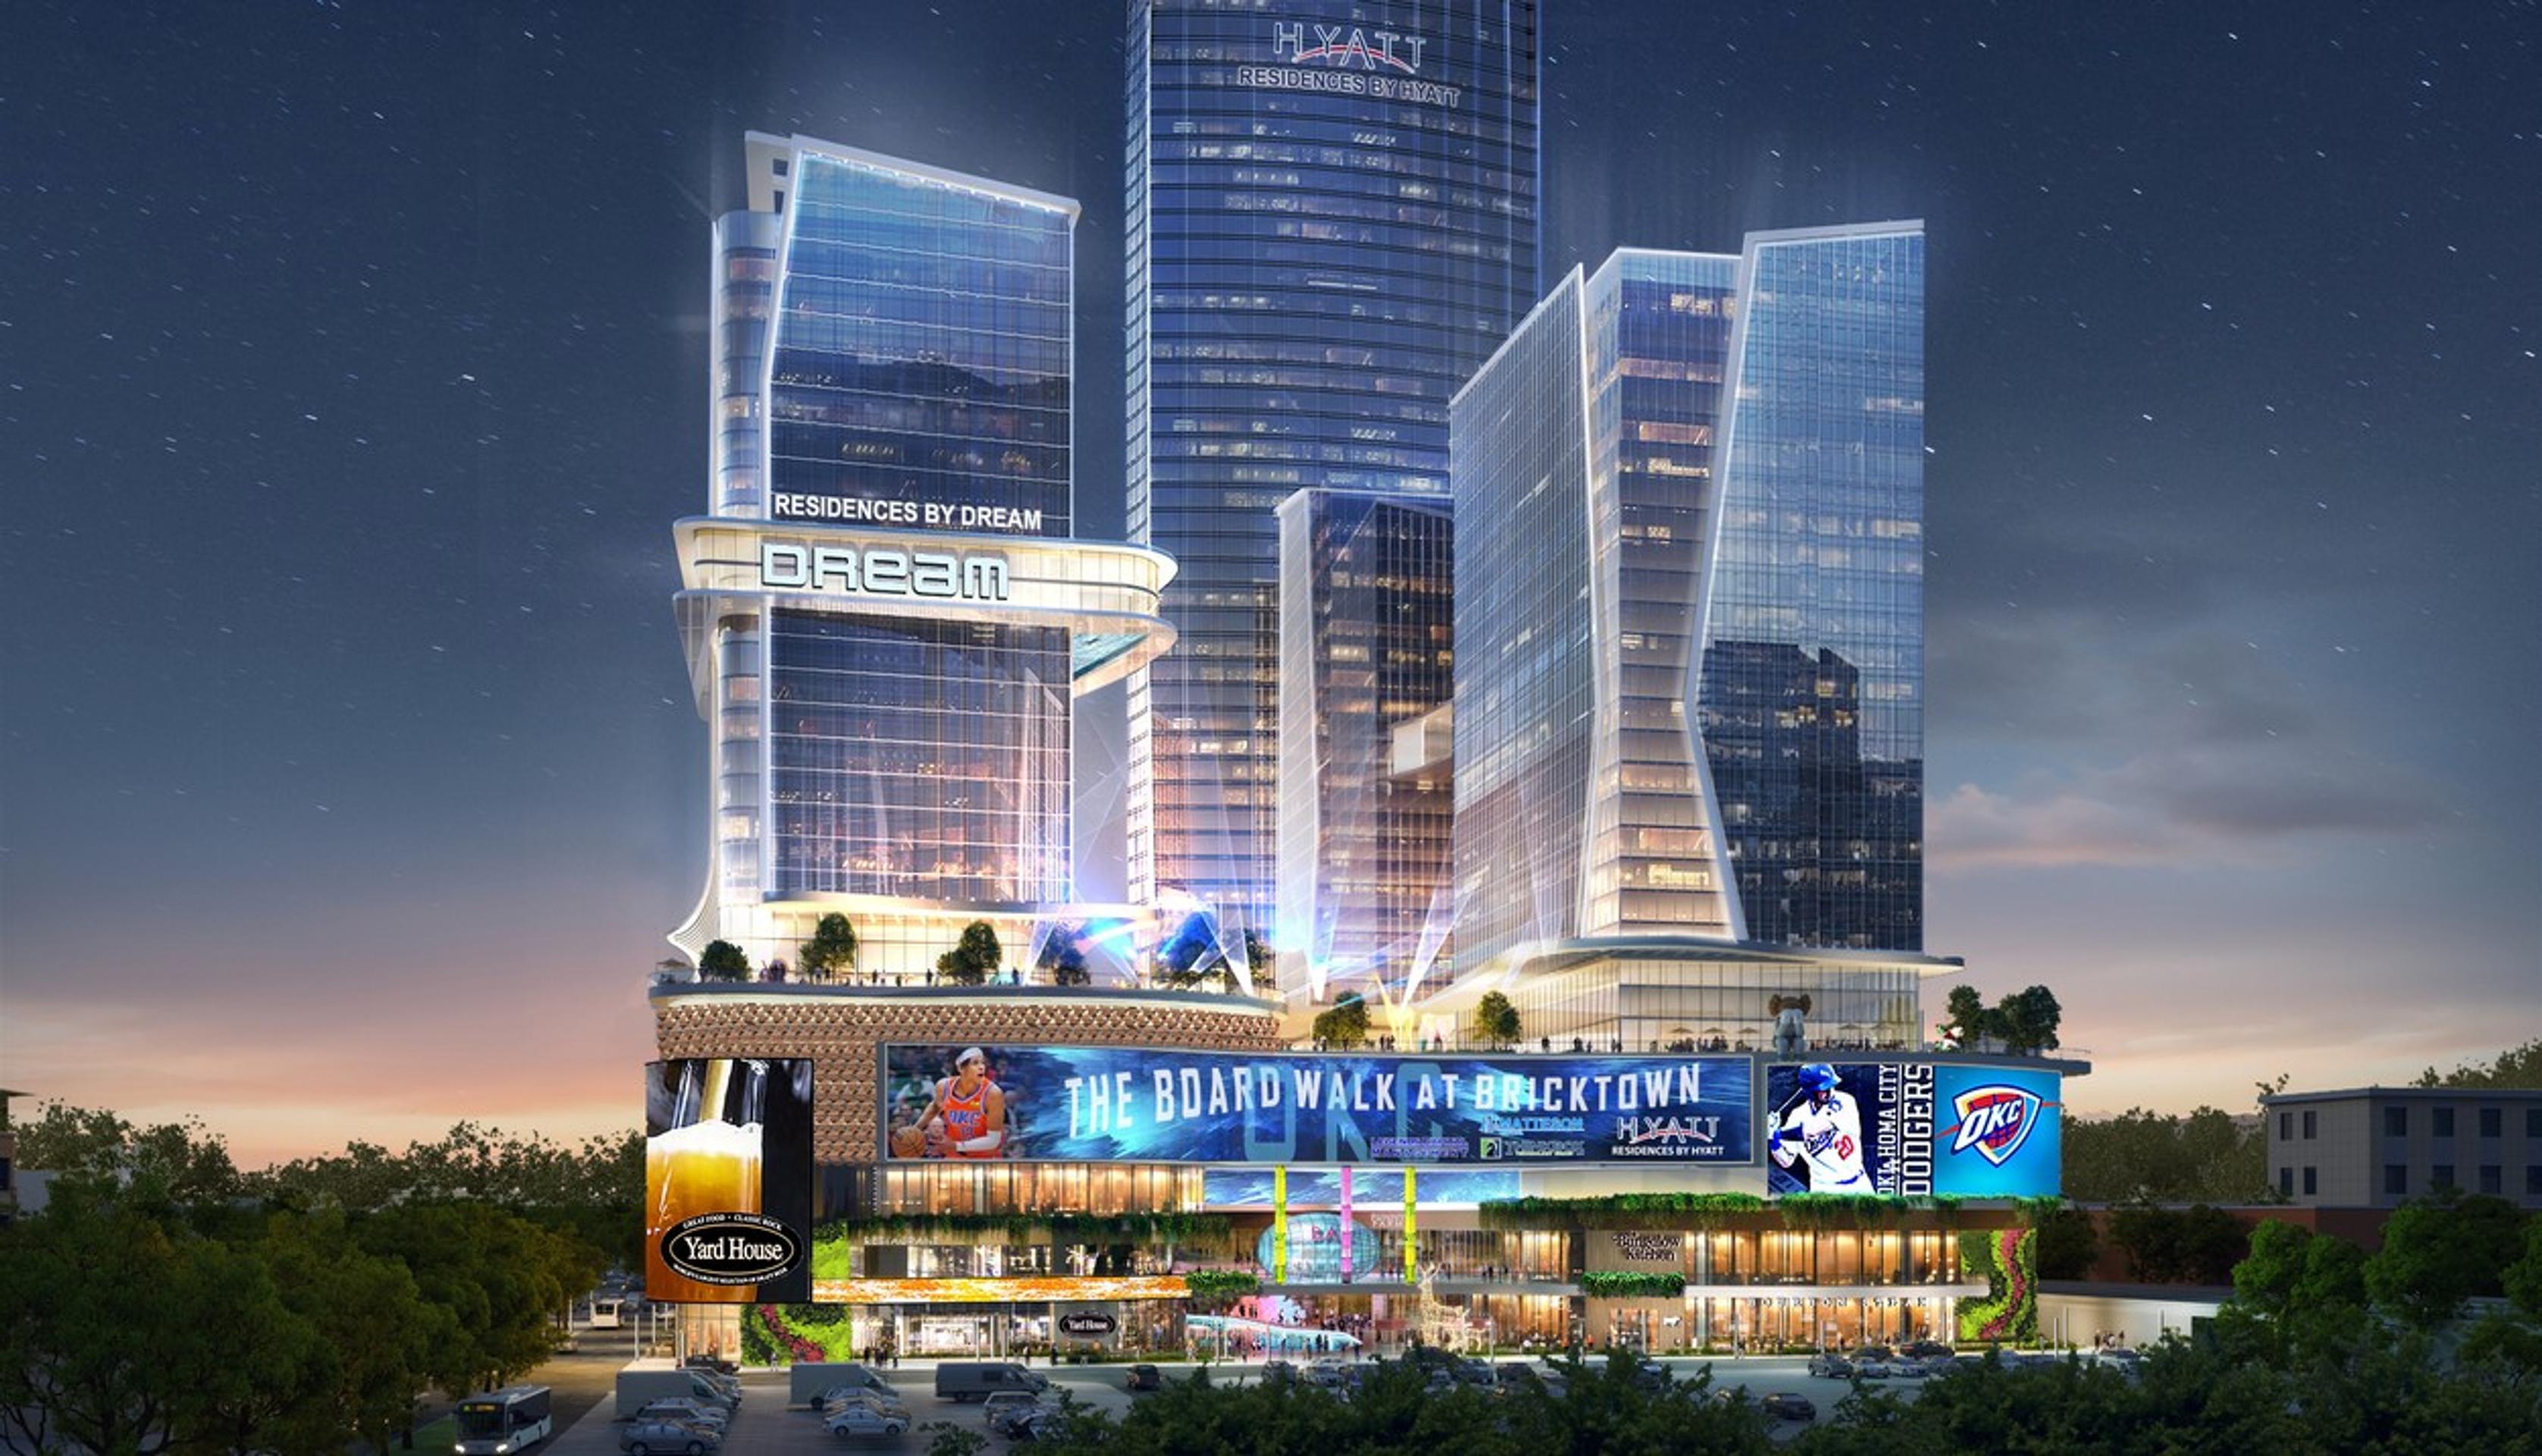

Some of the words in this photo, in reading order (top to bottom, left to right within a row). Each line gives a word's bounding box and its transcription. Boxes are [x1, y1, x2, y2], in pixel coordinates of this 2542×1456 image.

[1273, 22, 1426, 70] HYATT
[1238, 66, 1364, 94] RESIDENCES
[1370, 77, 1396, 97] BY
[1401, 83, 1461, 108] HYATT
[774, 494, 918, 523] RESIDENCES
[924, 505, 955, 524] BY
[961, 507, 1042, 530] DREAM
[1065, 1071, 1132, 1138] THE
[1153, 1065, 1281, 1122] BOARD
[1294, 1069, 1395, 1111] WALK
[1415, 1073, 1458, 1110] AT
[1474, 1062, 1700, 1112] BRICKTOWN
[1878, 1064, 1897, 1103] CITY
[1616, 1116, 1721, 1144] HYATT
[1902, 1064, 1933, 1197] DODGERS
[1954, 1098, 2023, 1151] OKC
[1612, 1145, 1674, 1156] RESIDENCES
[1676, 1145, 1690, 1156] BY
[1691, 1145, 1724, 1156] HYATT
[683, 1236, 725, 1260] Yard
[728, 1236, 783, 1260] House
[1067, 1320, 1085, 1330] Yard
[1086, 1320, 1107, 1330] House
